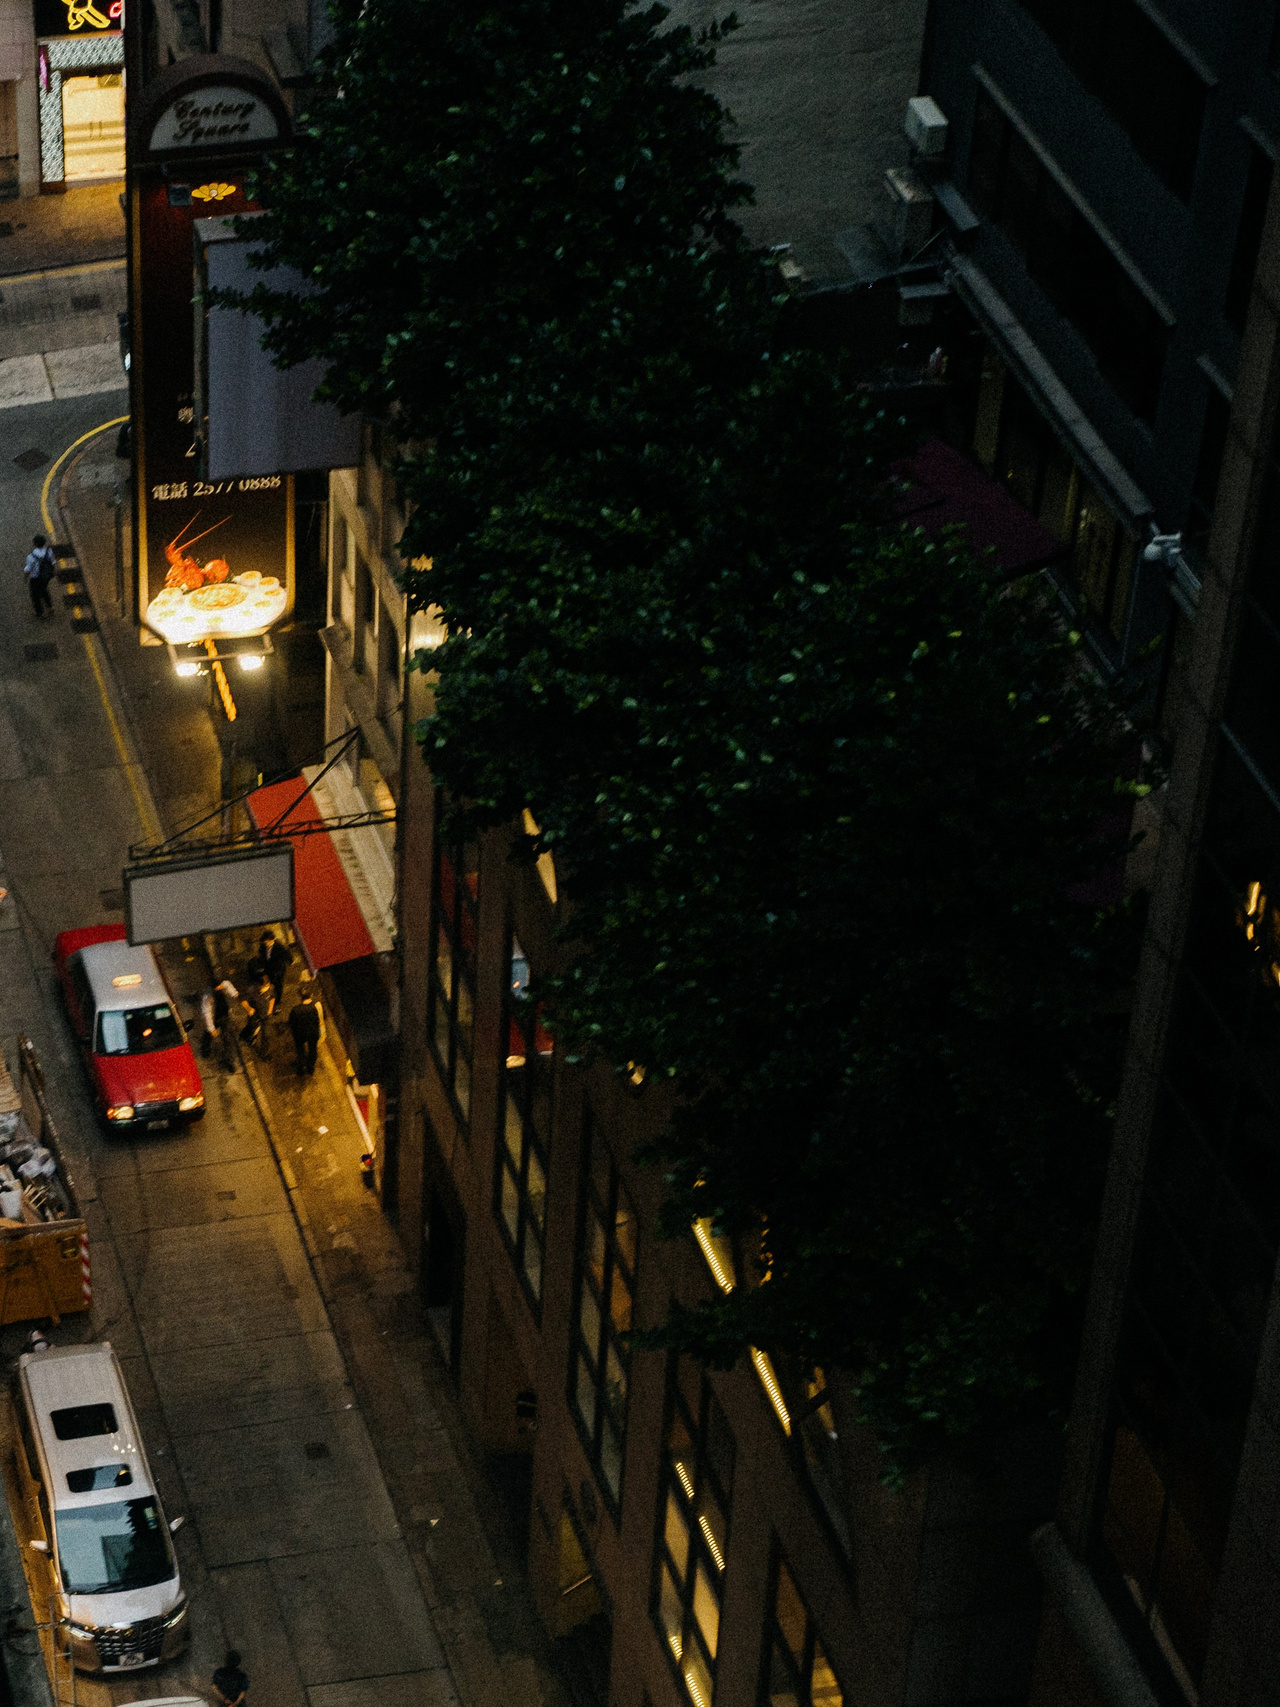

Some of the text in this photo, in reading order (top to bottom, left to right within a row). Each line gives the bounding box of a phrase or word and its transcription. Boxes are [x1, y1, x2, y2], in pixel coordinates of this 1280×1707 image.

[174, 99, 256, 120] Century
[172, 120, 250, 143] Square
[152, 481, 189, 501] 電話
